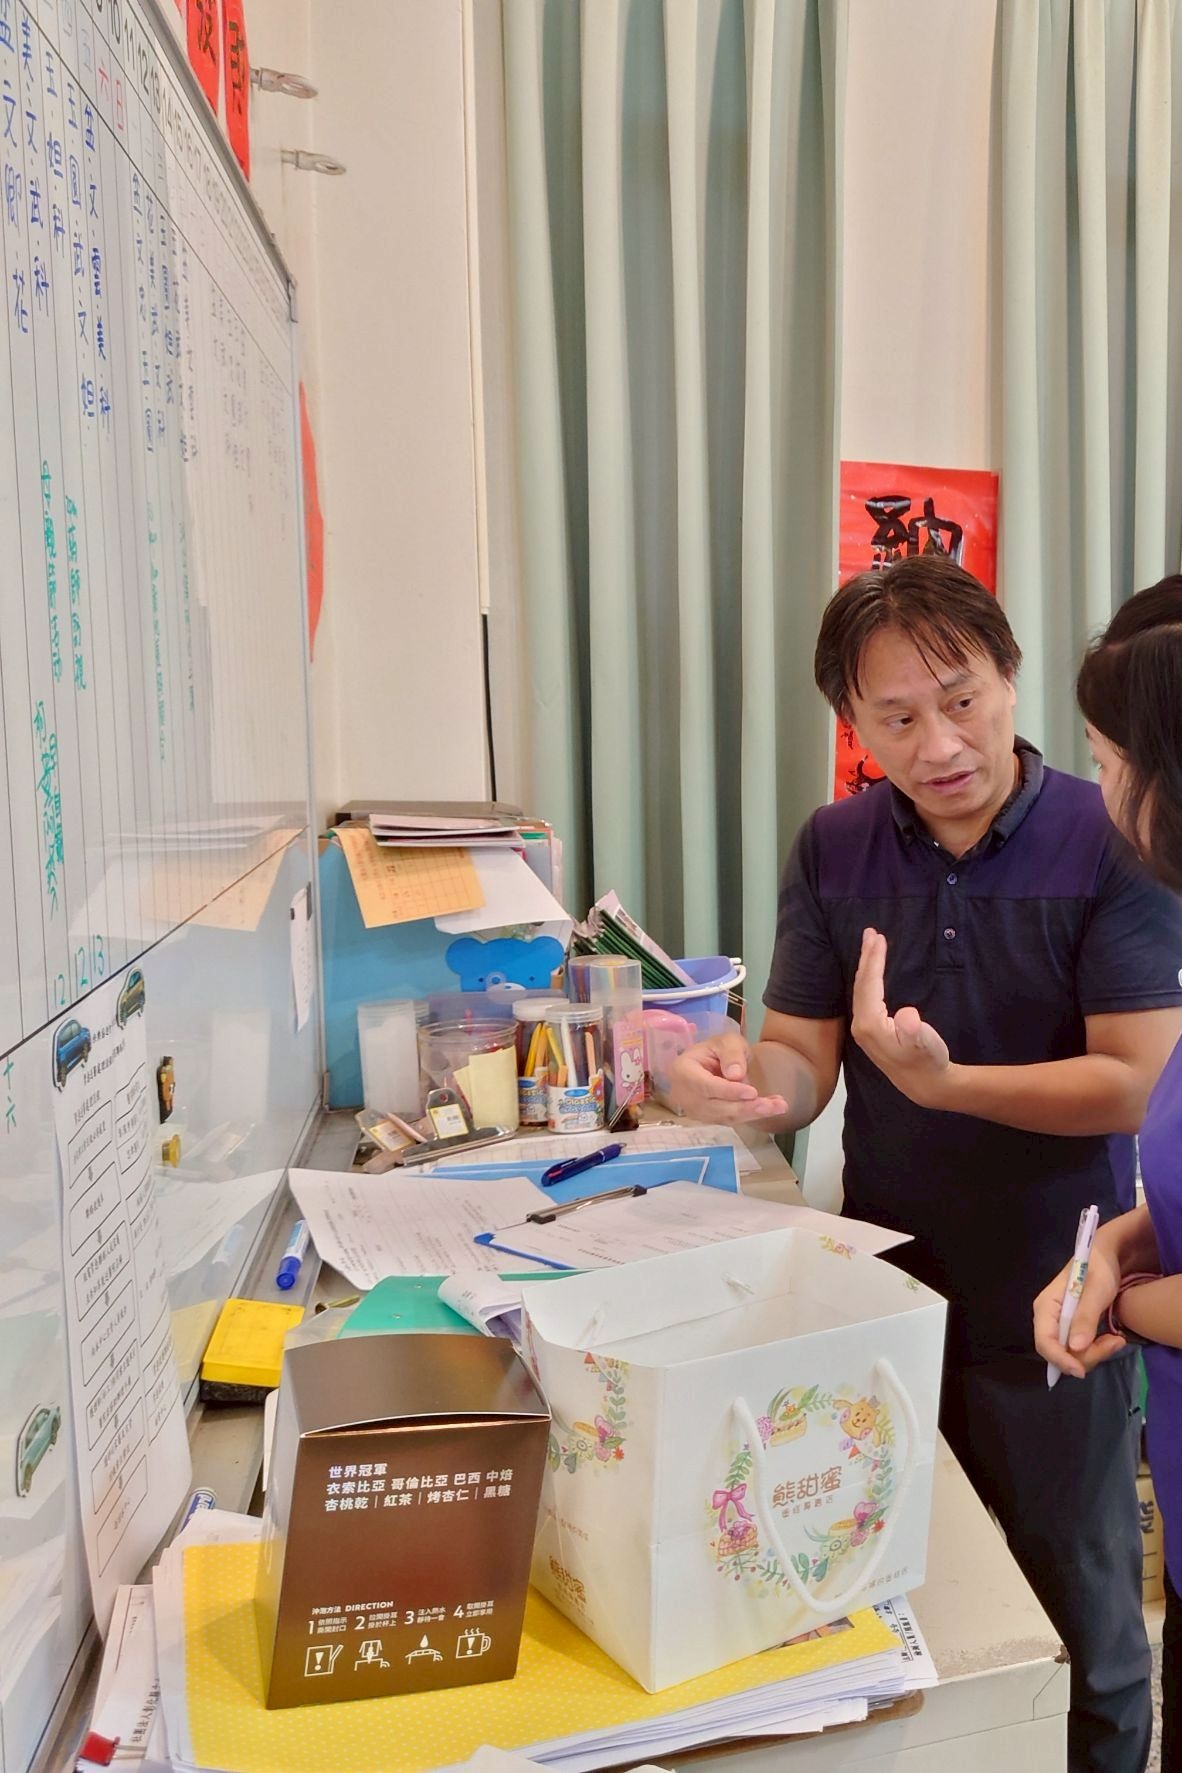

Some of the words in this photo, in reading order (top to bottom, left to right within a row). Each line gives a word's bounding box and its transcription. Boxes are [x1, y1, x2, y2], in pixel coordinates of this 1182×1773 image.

[124, 18, 135, 71] 11
[138, 43, 149, 96] 12
[151, 66, 161, 114] 13
[328, 1462, 388, 1479] 世界冠軍
[326, 1479, 386, 1495] 衣索比亞
[391, 1474, 449, 1491] 哥倫比亞
[453, 1471, 482, 1486] 巴西
[773, 1465, 842, 1509] 熊甜蜜
[324, 1497, 369, 1512] 杏桃乾
[383, 1493, 413, 1508] 紅茶
[483, 1484, 512, 1499] 黑糖
[345, 1600, 394, 1613] DIRECTION
[453, 1605, 464, 1618] 4
[308, 1620, 315, 1635] 1
[354, 1615, 365, 1630] 2
[404, 1610, 415, 1625] 3
